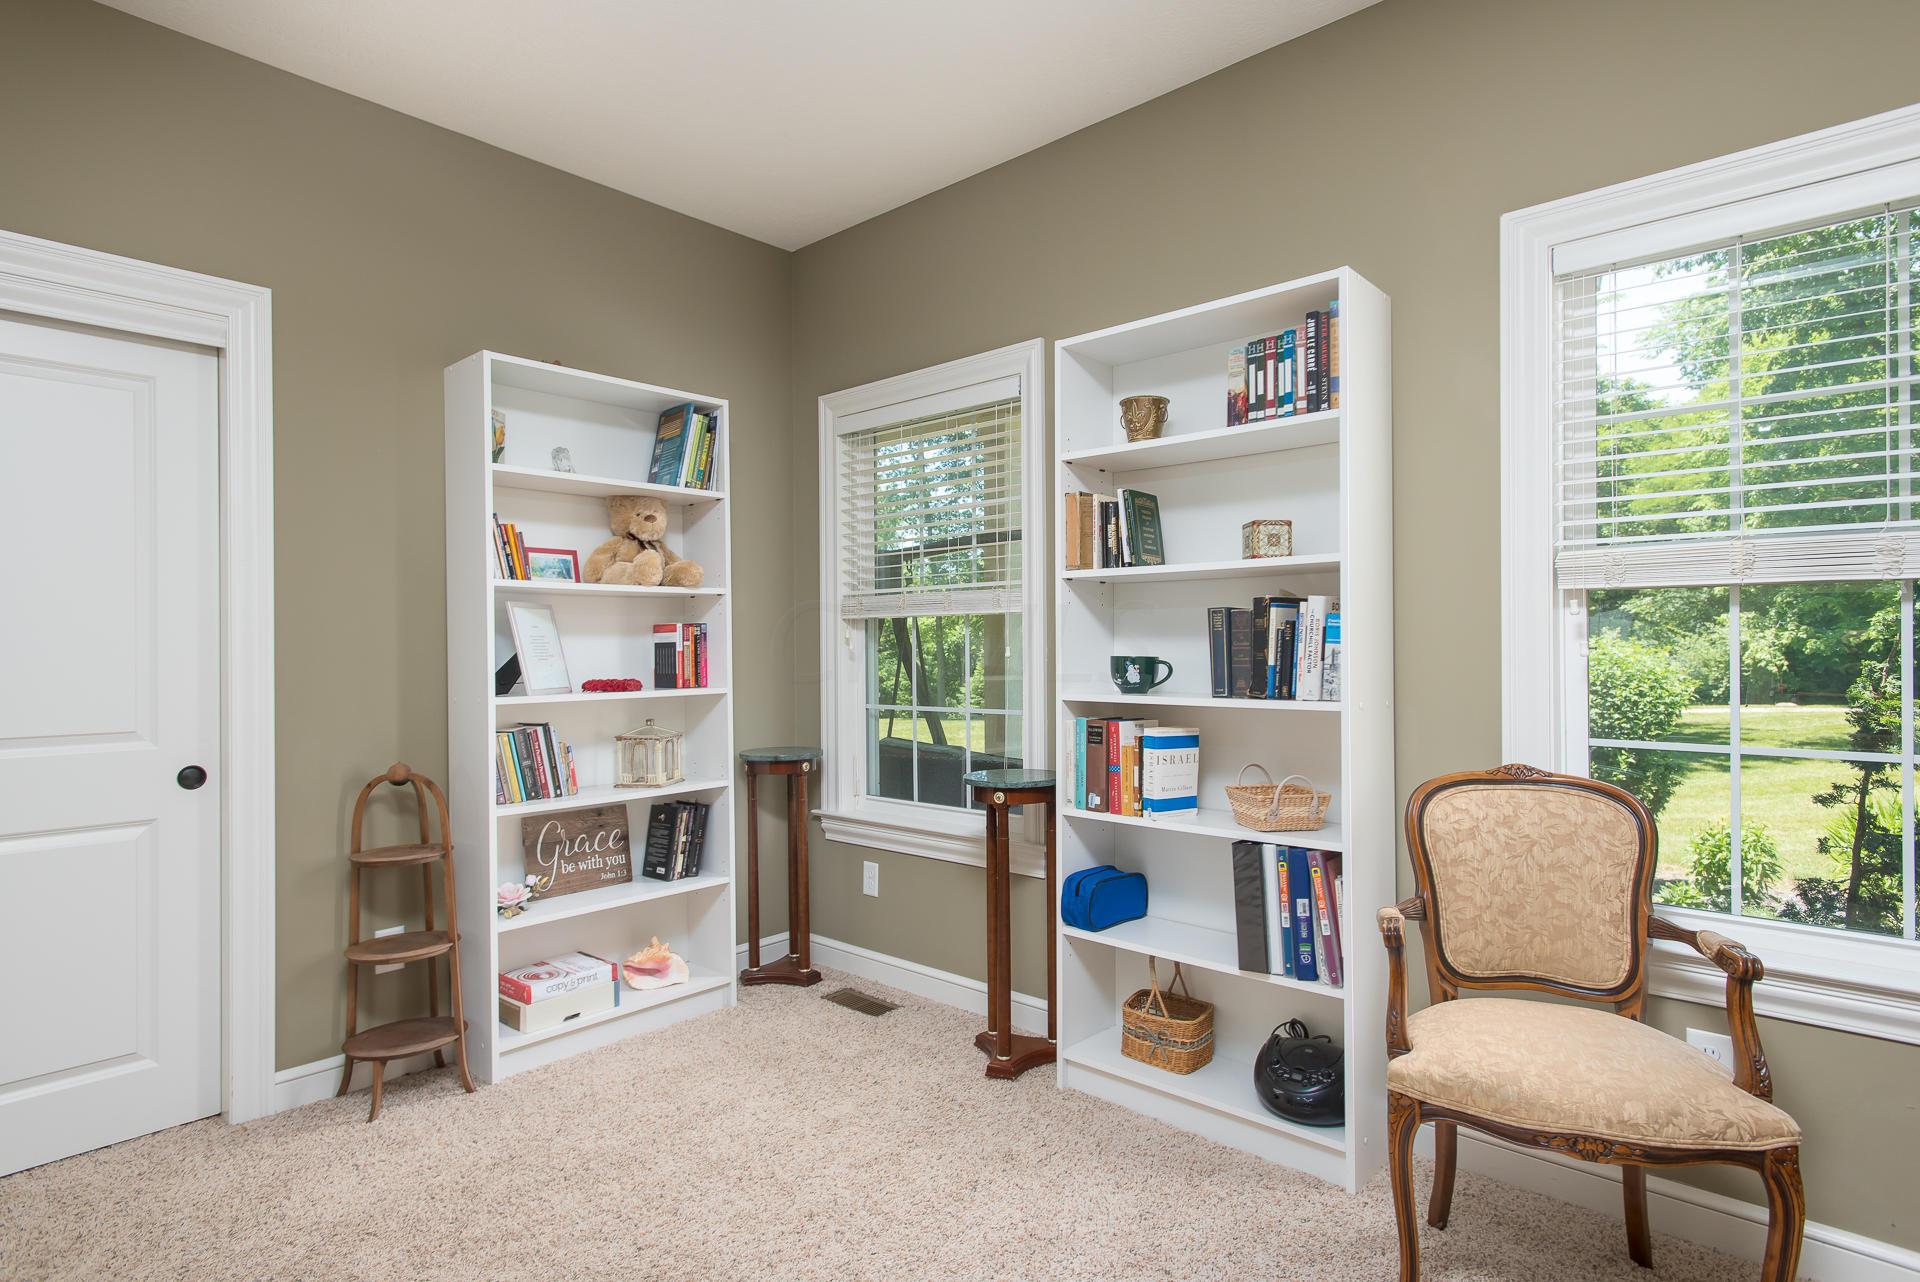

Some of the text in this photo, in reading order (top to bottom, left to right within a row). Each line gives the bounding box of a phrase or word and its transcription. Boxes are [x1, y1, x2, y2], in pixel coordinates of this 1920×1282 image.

[1284, 335, 1294, 344] H
[1297, 330, 1306, 340] H
[1248, 345, 1256, 354] H
[1257, 343, 1265, 352] H
[1266, 340, 1275, 349] H
[1156, 753, 1199, 766] ISRAEL
[536, 820, 625, 892] Grace
[561, 853, 626, 874] be with you
[600, 869, 627, 881] John 1:3
[545, 981, 569, 993] copy
[576, 972, 599, 986] print
